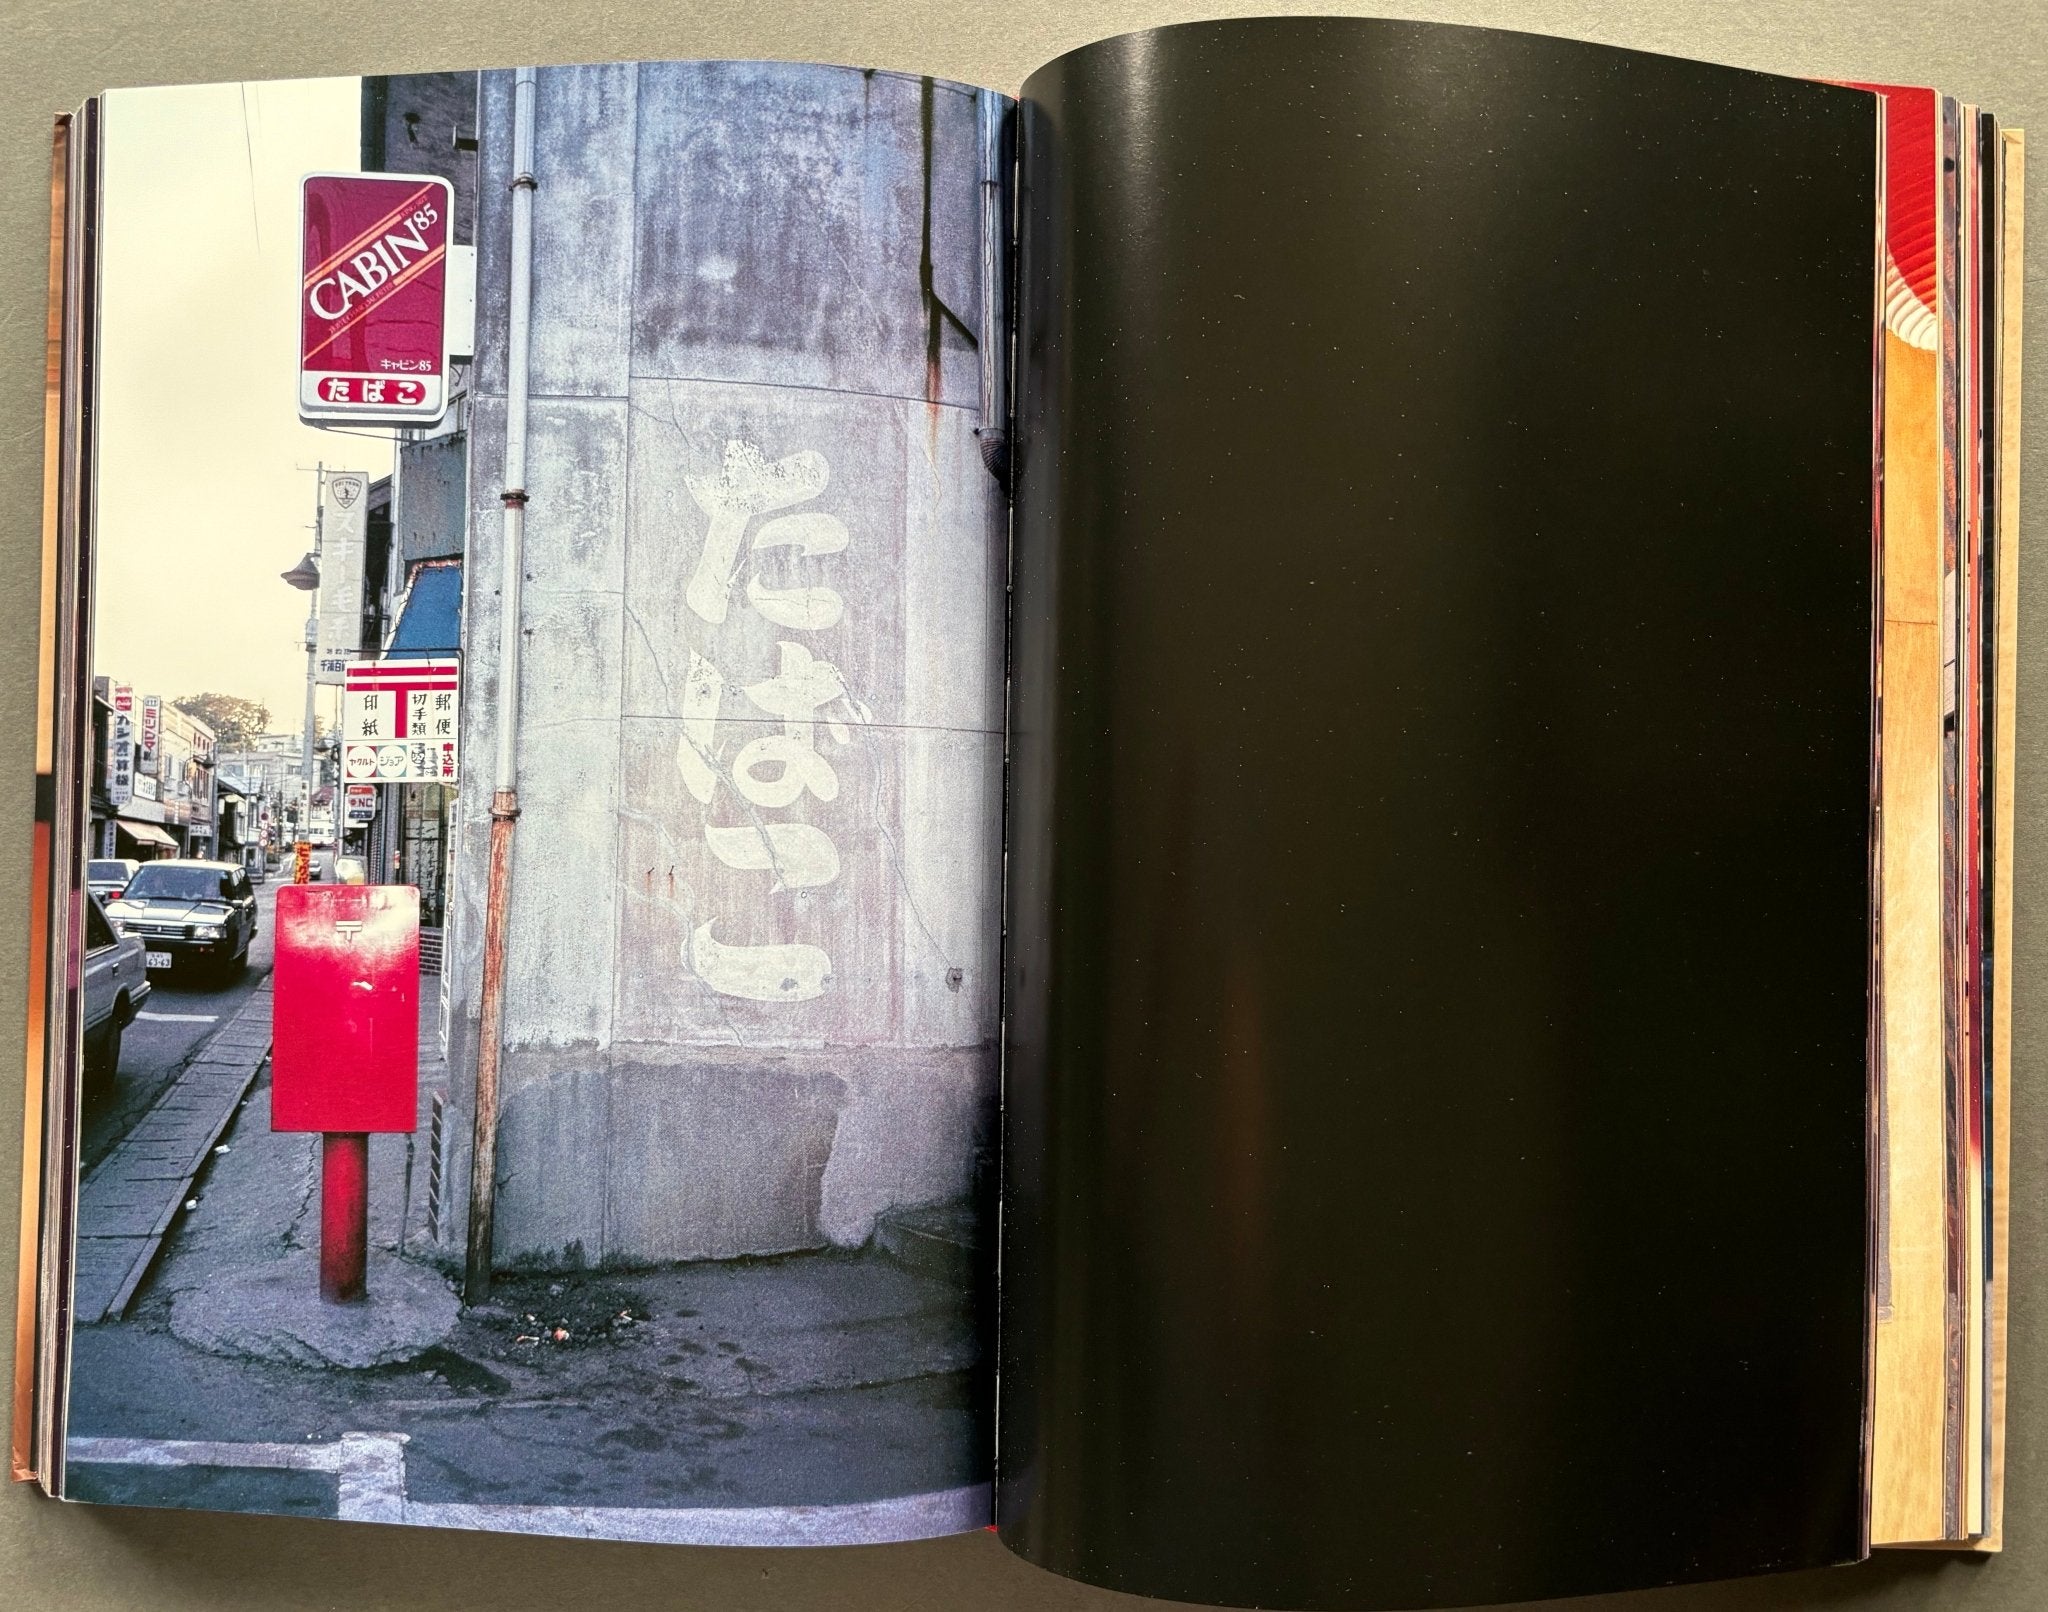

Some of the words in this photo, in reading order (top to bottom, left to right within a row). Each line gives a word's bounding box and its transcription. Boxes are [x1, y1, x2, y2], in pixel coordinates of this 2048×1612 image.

[310, 219, 429, 320] CABIN
[413, 203, 438, 232] 85
[327, 379, 418, 404] たばこ
[362, 694, 379, 736] 印紙
[412, 693, 428, 735] 切手類
[435, 693, 452, 735] 郵便
[677, 439, 872, 1002] たばこ
[349, 758, 375, 766] ヤクルト
[380, 756, 403, 766] ジョア
[442, 742, 455, 777] 申込所
